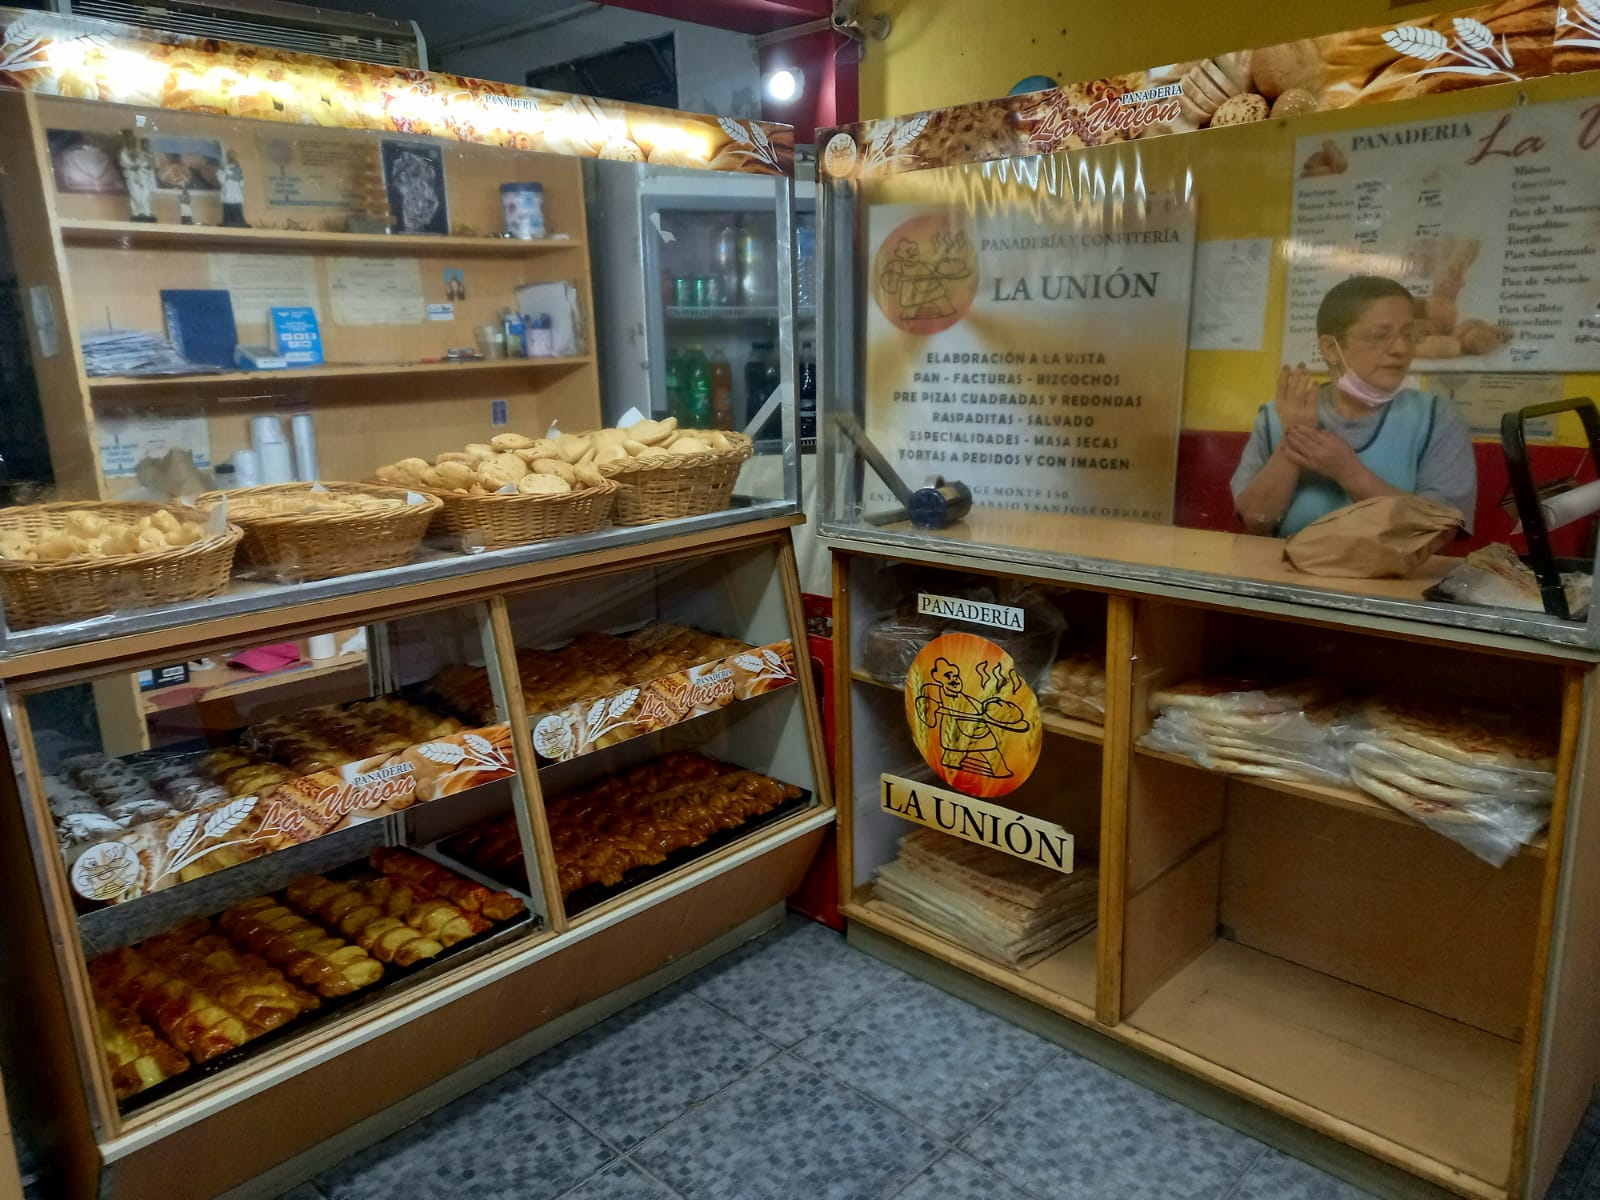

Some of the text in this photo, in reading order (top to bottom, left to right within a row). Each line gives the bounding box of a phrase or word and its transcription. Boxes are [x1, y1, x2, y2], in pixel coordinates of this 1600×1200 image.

[1122, 84, 1183, 104] PANADERIA
[1028, 98, 1182, 144] La Union
[1351, 121, 1473, 151] PANADERIA
[1465, 113, 1545, 166] La
[992, 266, 1160, 302] LA UNIÓN
[927, 351, 1105, 365] ELABORACIÓN A LA VISTA
[914, 372, 940, 384] PAN
[953, 373, 1023, 385] FACTURAS
[1037, 374, 1120, 386] BIZCOCHOS
[894, 391, 1142, 408] PRE PIZAS CUADRADAS Y REDONDAS
[932, 412, 1014, 425] RASPADITAS
[1027, 414, 1094, 427] SALVADO
[909, 430, 1020, 445] ESPECIALIDADES
[1034, 436, 1071, 448] MASA
[1076, 437, 1118, 449] SECAS
[899, 449, 1130, 470] TORTAS A PEDIDOS Y CON IMAGEN
[921, 596, 1022, 629] PANADERÍA
[696, 669, 733, 685] PANADERIA
[635, 679, 735, 724] La Union
[354, 762, 414, 786] PANADERIA
[251, 774, 416, 843] La Union
[883, 780, 1067, 868] LA UNIÓN
